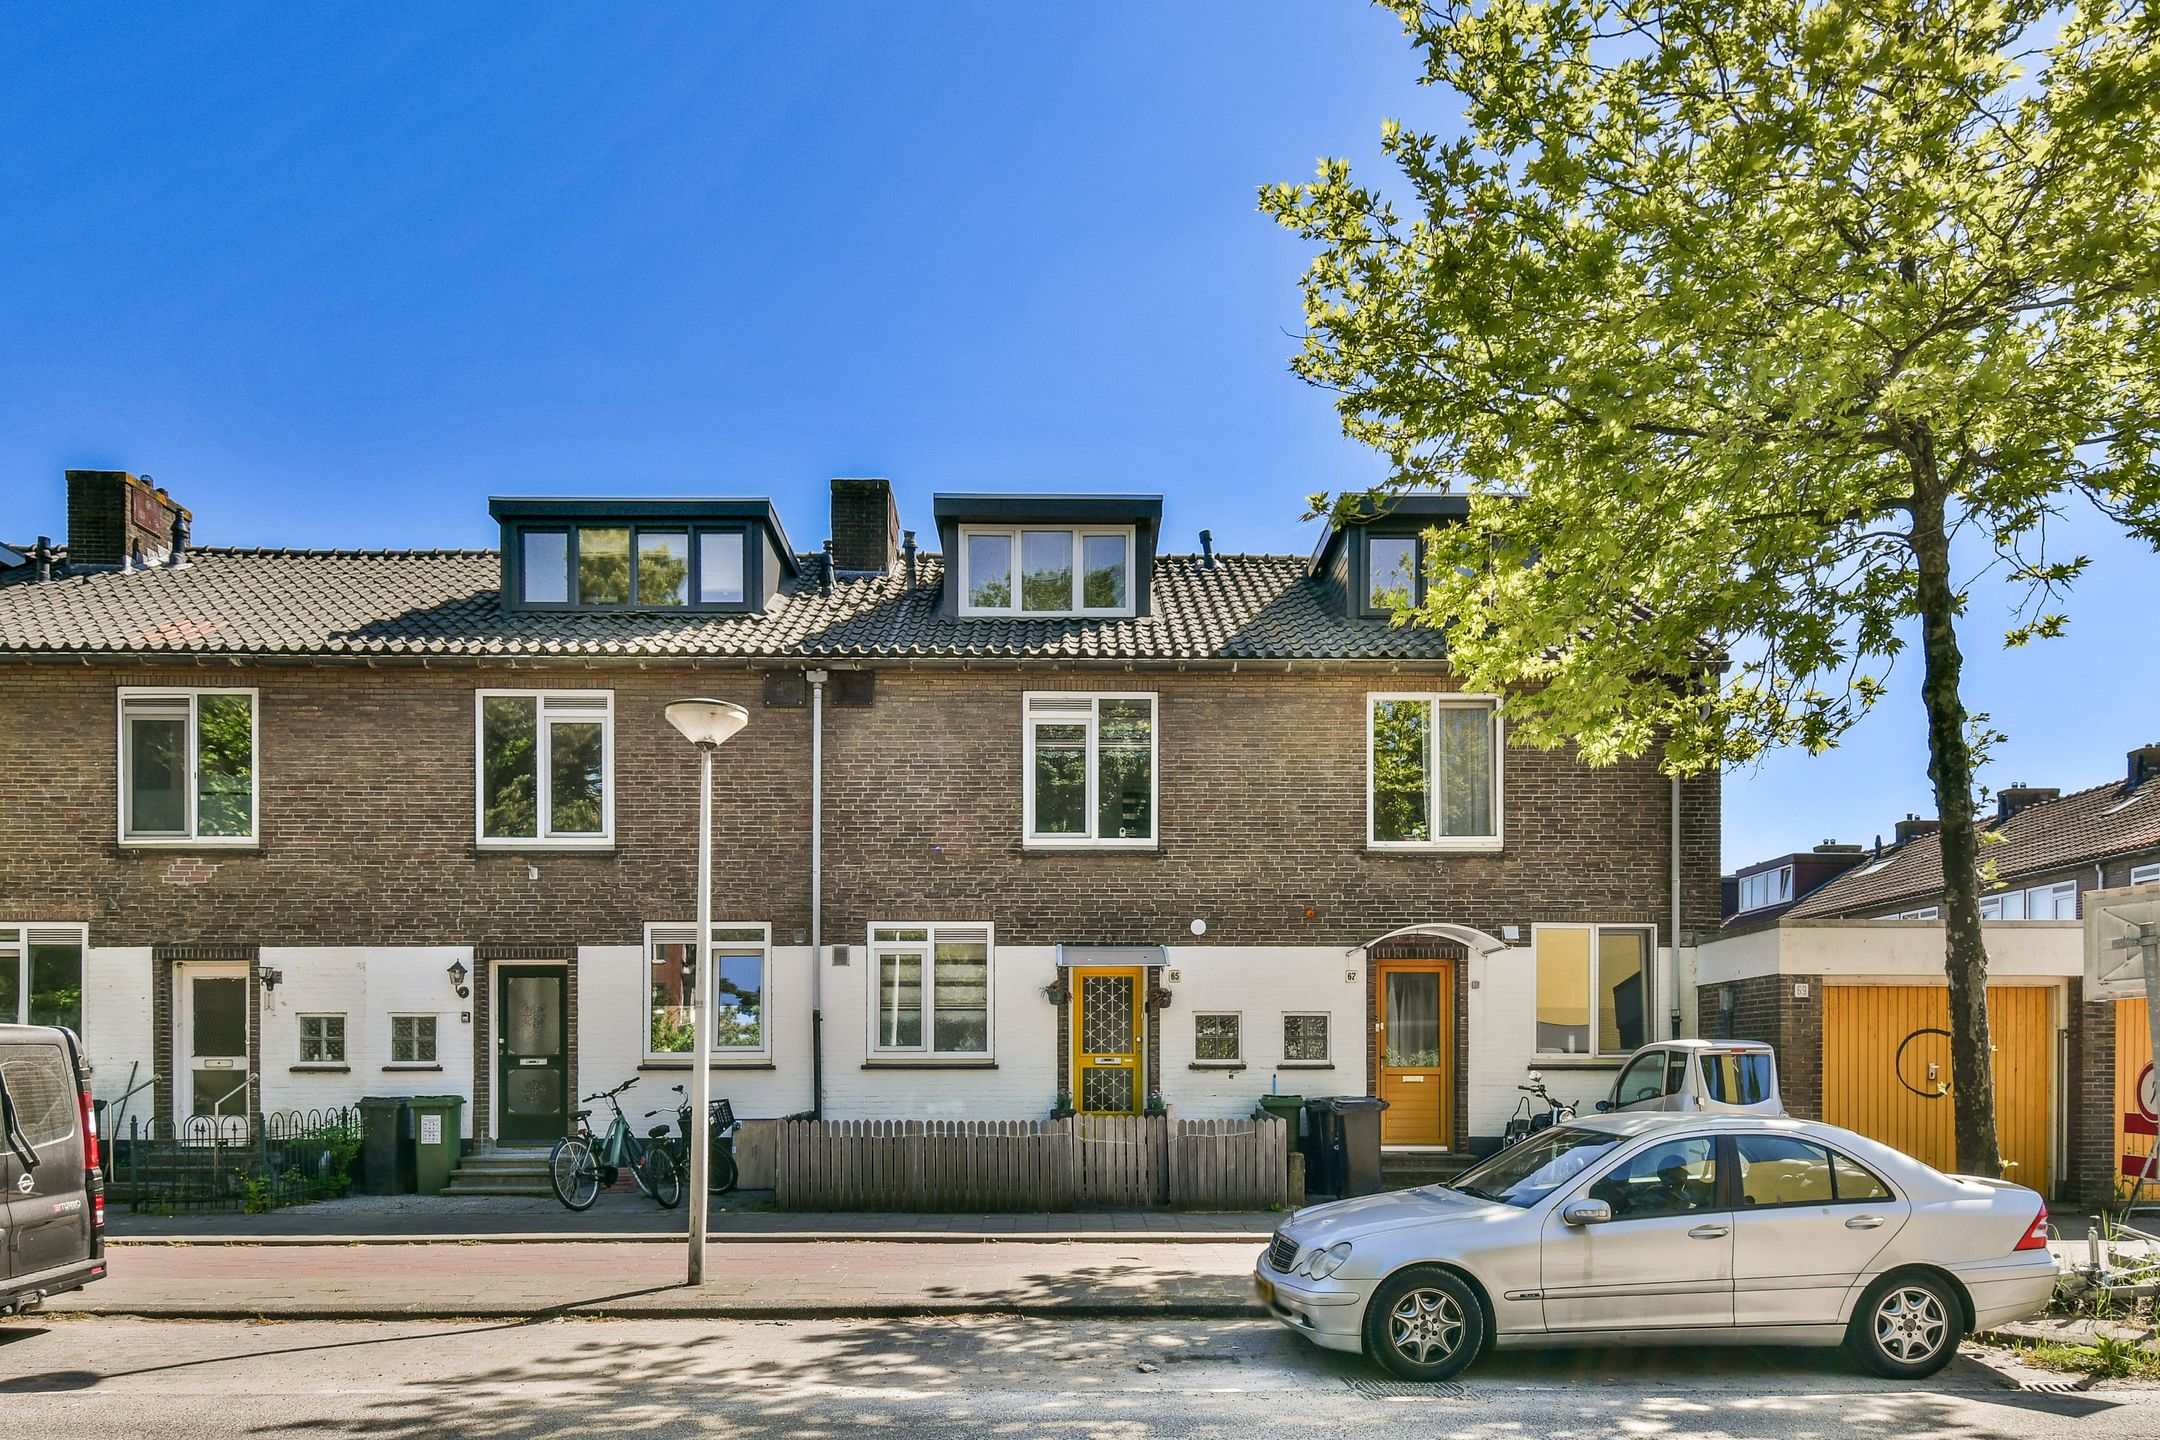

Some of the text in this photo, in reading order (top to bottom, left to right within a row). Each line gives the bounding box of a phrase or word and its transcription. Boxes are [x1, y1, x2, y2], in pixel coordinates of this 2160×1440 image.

[1170, 971, 1180, 981] 65
[1347, 972, 1357, 981] 67
[1797, 985, 1807, 996] 69
